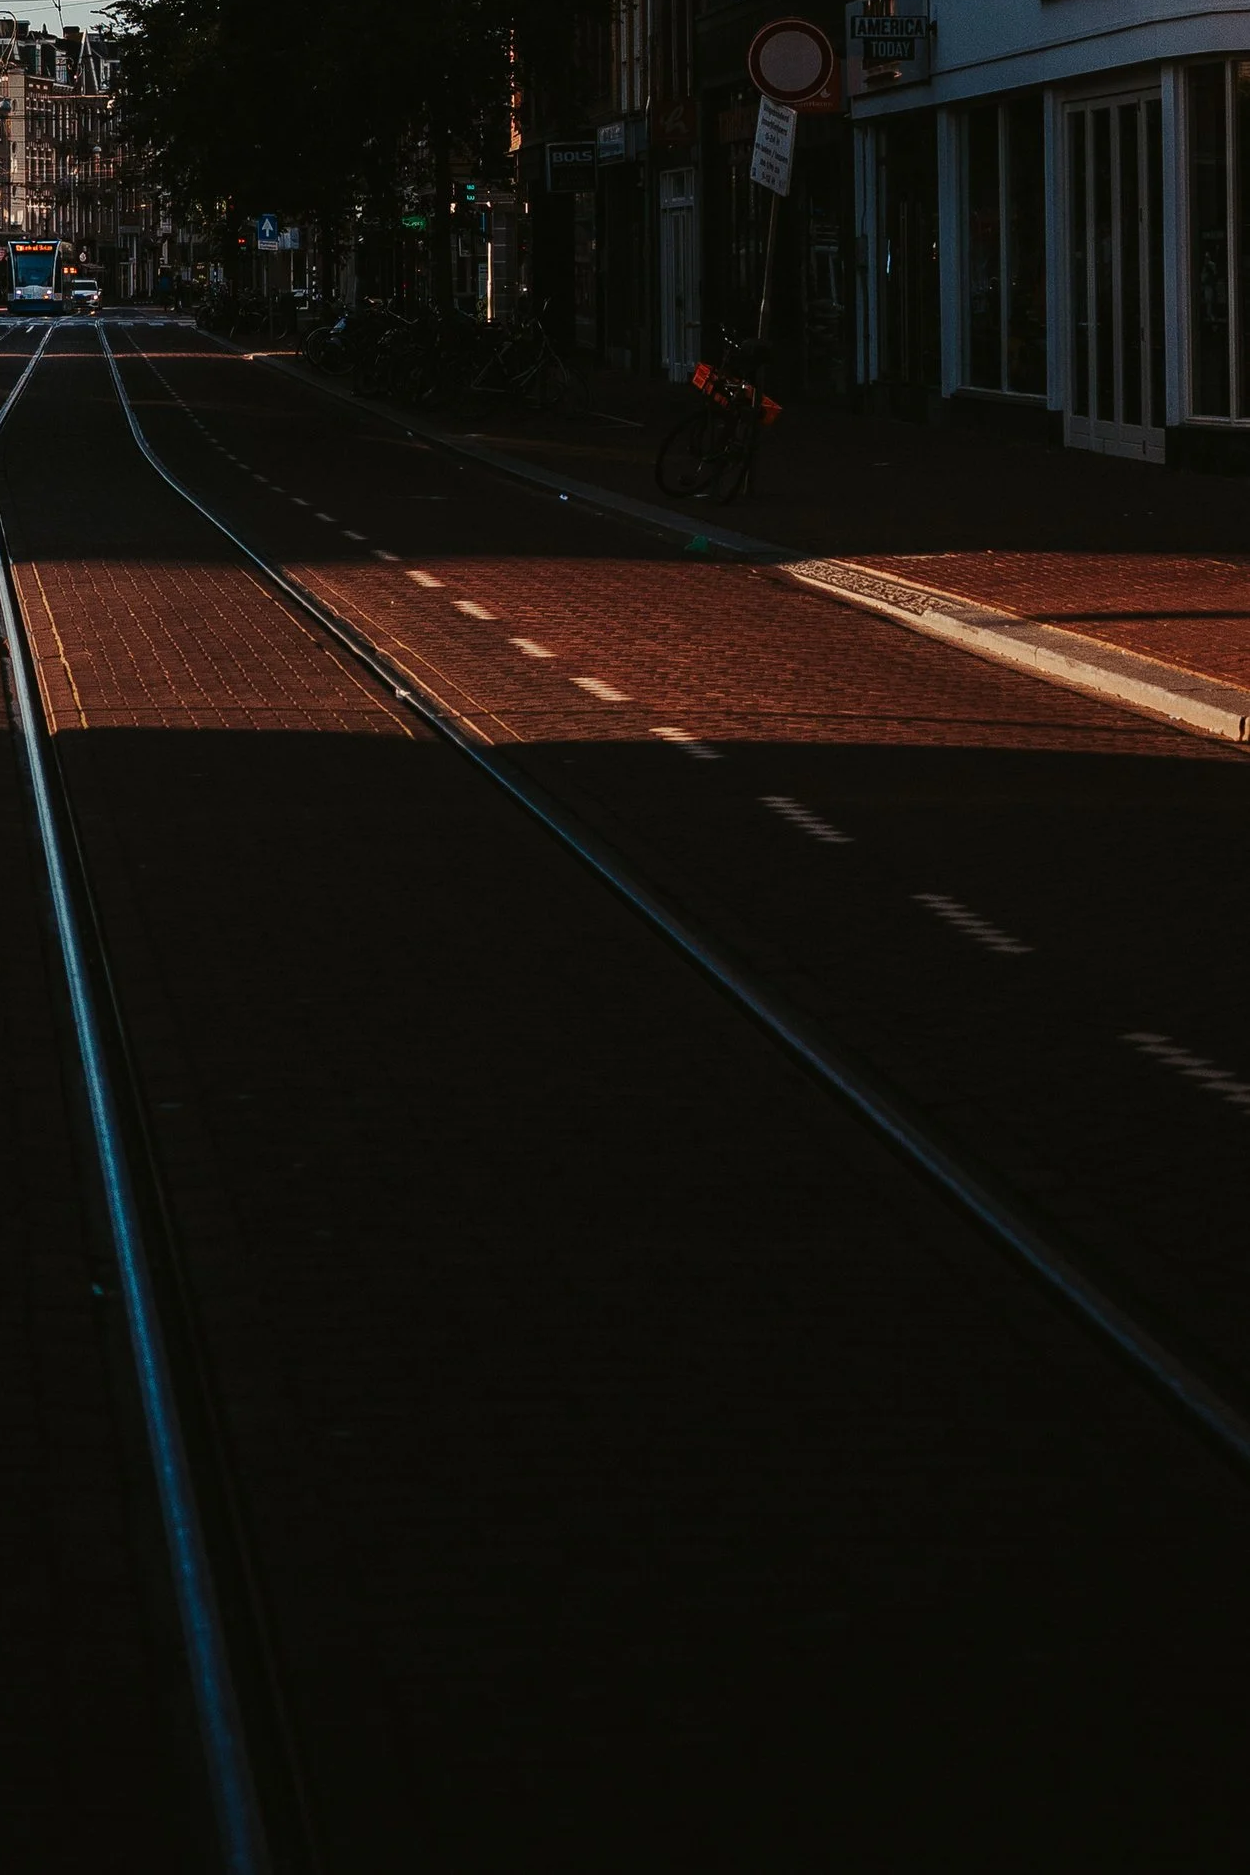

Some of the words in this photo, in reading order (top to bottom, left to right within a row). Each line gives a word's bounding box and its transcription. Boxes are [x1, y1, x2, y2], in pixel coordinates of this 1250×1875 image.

[857, 18, 924, 36] AMERICA
[871, 40, 910, 58] TODAY
[552, 150, 593, 163] BOLS
